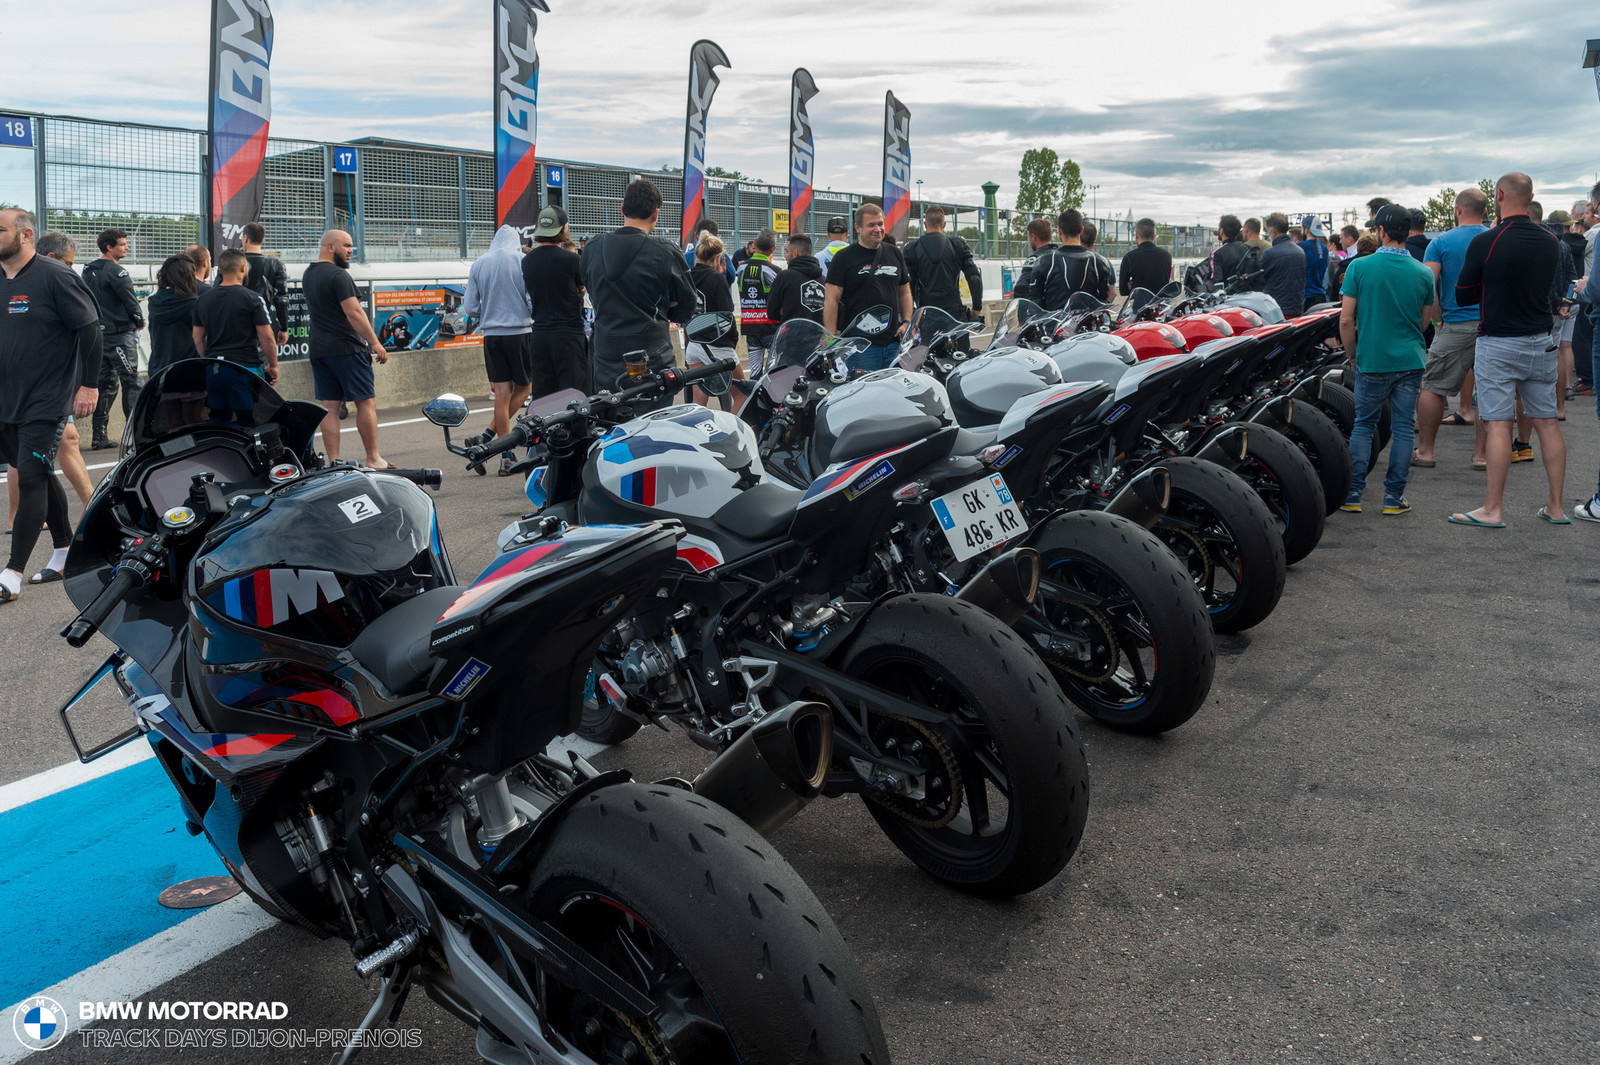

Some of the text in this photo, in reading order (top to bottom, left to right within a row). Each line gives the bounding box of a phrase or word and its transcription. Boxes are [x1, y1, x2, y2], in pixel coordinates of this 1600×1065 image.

[219, 0, 271, 122] BM
[5, 121, 25, 138] 18
[339, 152, 352, 166] 17
[551, 170, 561, 182] 16
[741, 311, 768, 319] otocar
[703, 423, 714, 432] 3
[857, 466, 888, 490] MICHELIN
[999, 490, 1011, 502] 78
[352, 500, 369, 516] 2
[943, 516, 949, 525] F
[432, 624, 475, 647] competition
[453, 665, 481, 695] MICHELIN
